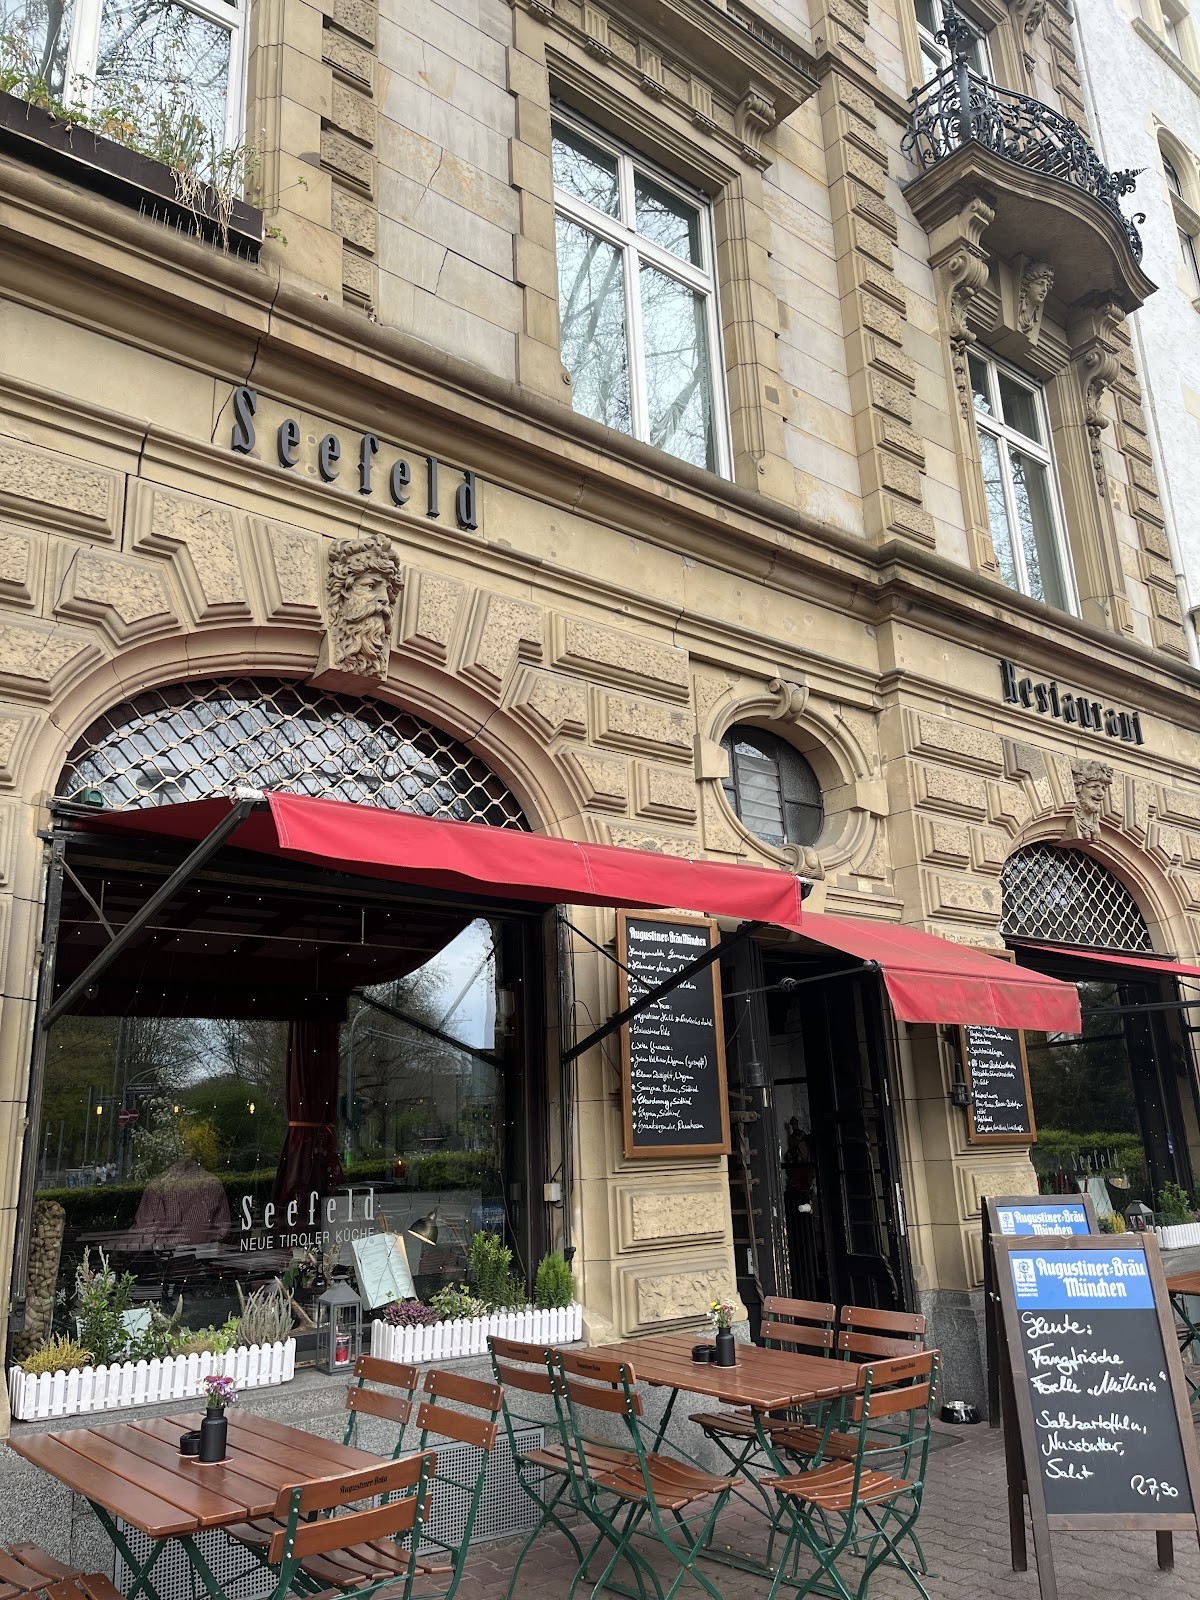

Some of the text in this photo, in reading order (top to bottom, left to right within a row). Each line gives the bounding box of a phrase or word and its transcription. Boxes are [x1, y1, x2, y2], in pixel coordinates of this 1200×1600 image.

[231, 386, 478, 531] Seefeld
[999, 659, 1145, 745] Restaurant
[1071, 1149, 1119, 1171] Seefeld
[241, 1188, 375, 1231] Seefeld
[240, 1228, 374, 1251] NEUE TIROLER KÜCHE
[1063, 1278, 1127, 1298] München
[1021, 1311, 1093, 1338] Heute:
[1027, 1342, 1124, 1375] Fangfrische
[1030, 1372, 1081, 1394] Forelle
[1036, 1410, 1147, 1434] Salzkartoffeln,
[1042, 1431, 1125, 1456] Nussbutter,
[1045, 1458, 1095, 1479] Salat
